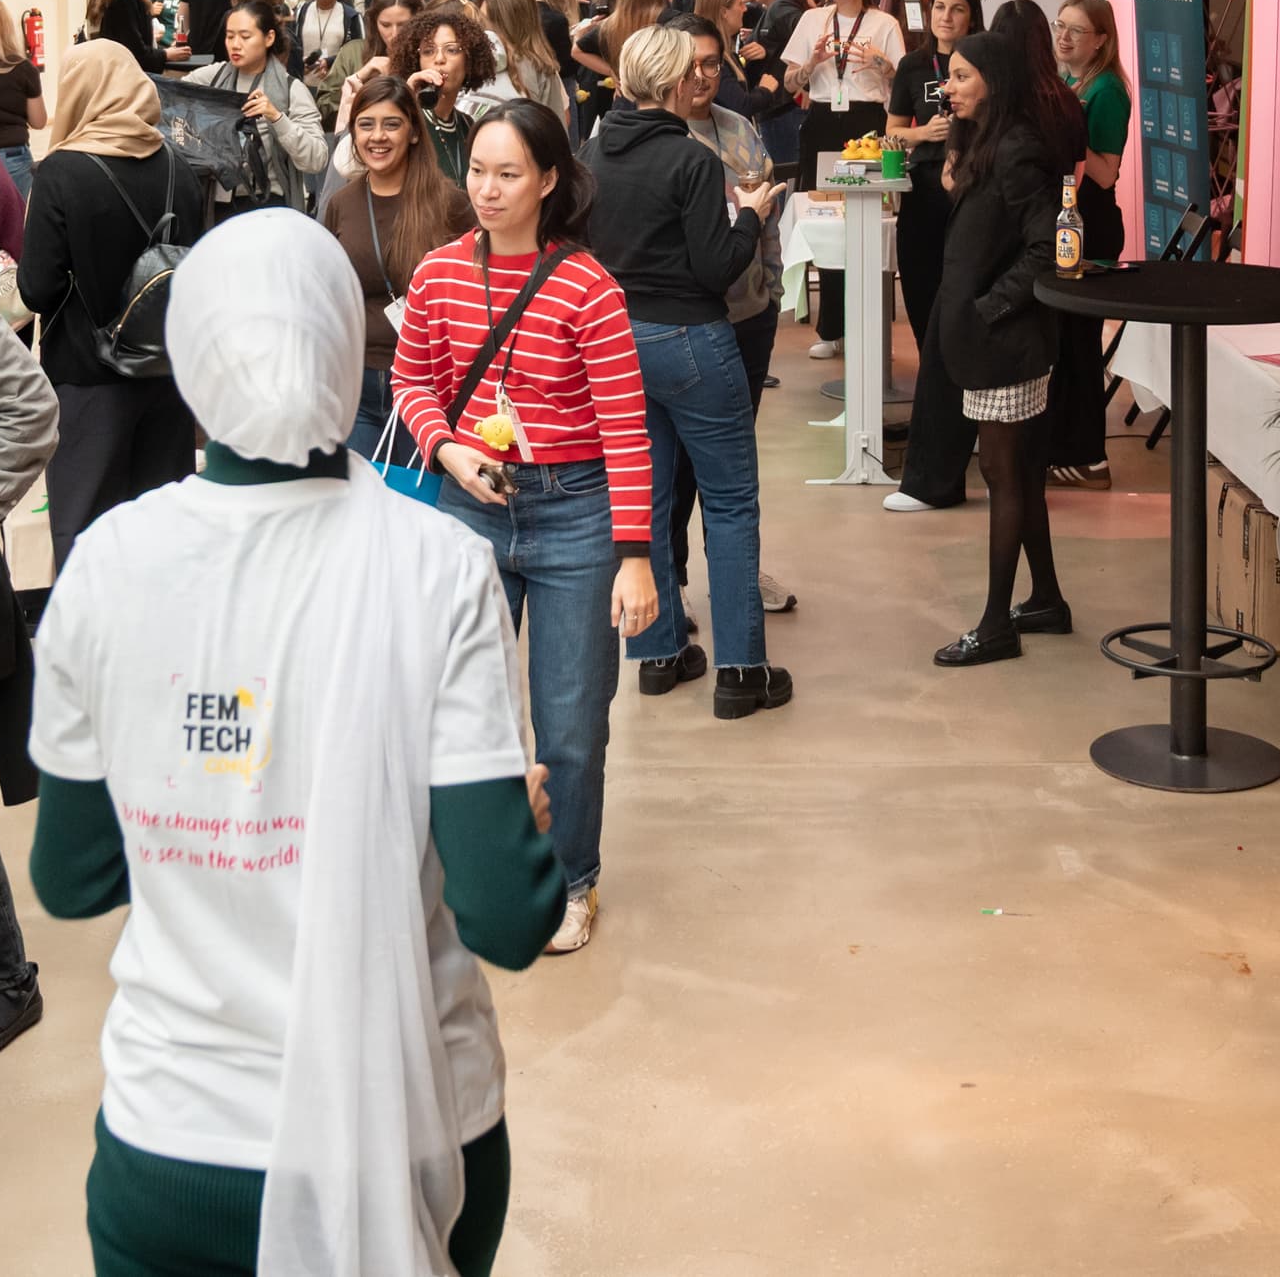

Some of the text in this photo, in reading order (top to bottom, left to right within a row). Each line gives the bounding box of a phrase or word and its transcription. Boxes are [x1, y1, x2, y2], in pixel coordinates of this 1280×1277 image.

[186, 692, 240, 721] FEM
[183, 724, 252, 752] TECH
[136, 806, 160, 827] the
[166, 811, 231, 841] change
[236, 818, 268, 837] you
[159, 846, 183, 863] see
[209, 850, 237, 870] the
